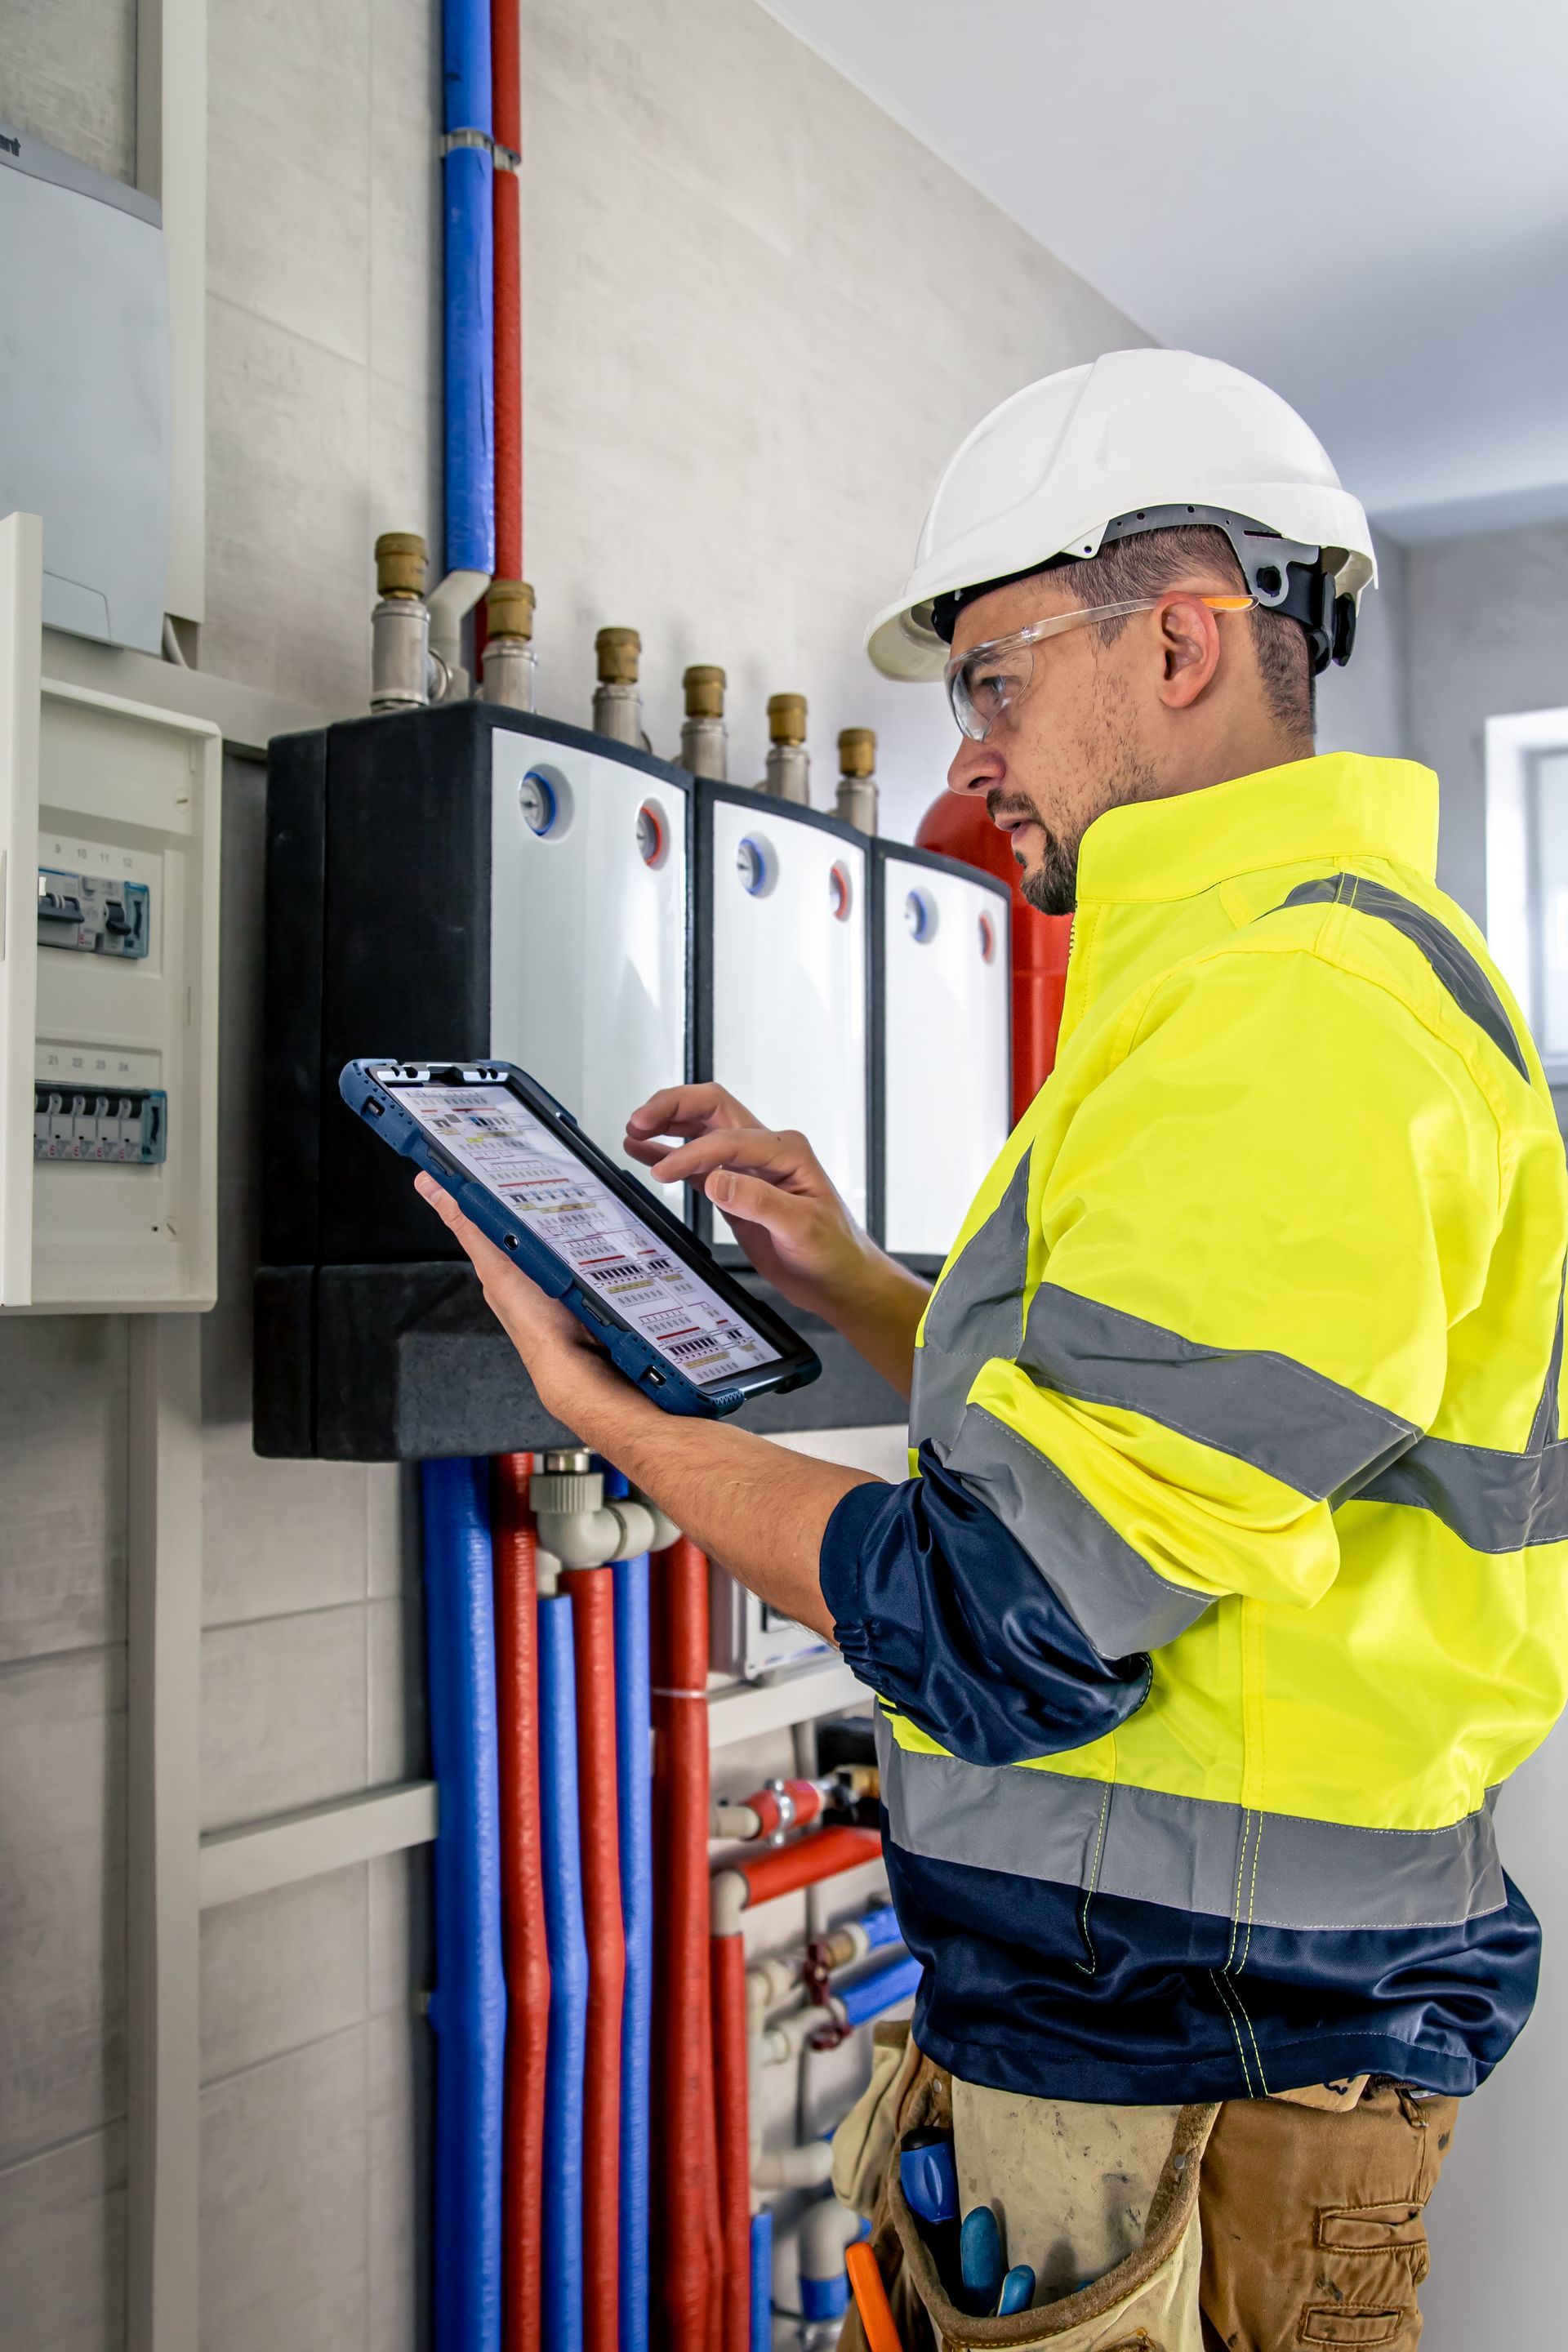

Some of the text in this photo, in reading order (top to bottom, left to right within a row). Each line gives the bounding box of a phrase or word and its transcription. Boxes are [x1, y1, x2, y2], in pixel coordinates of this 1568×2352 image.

[55, 844, 132, 868] 9 10 11 12
[49, 1055, 129, 1071] 21 22 23 24
